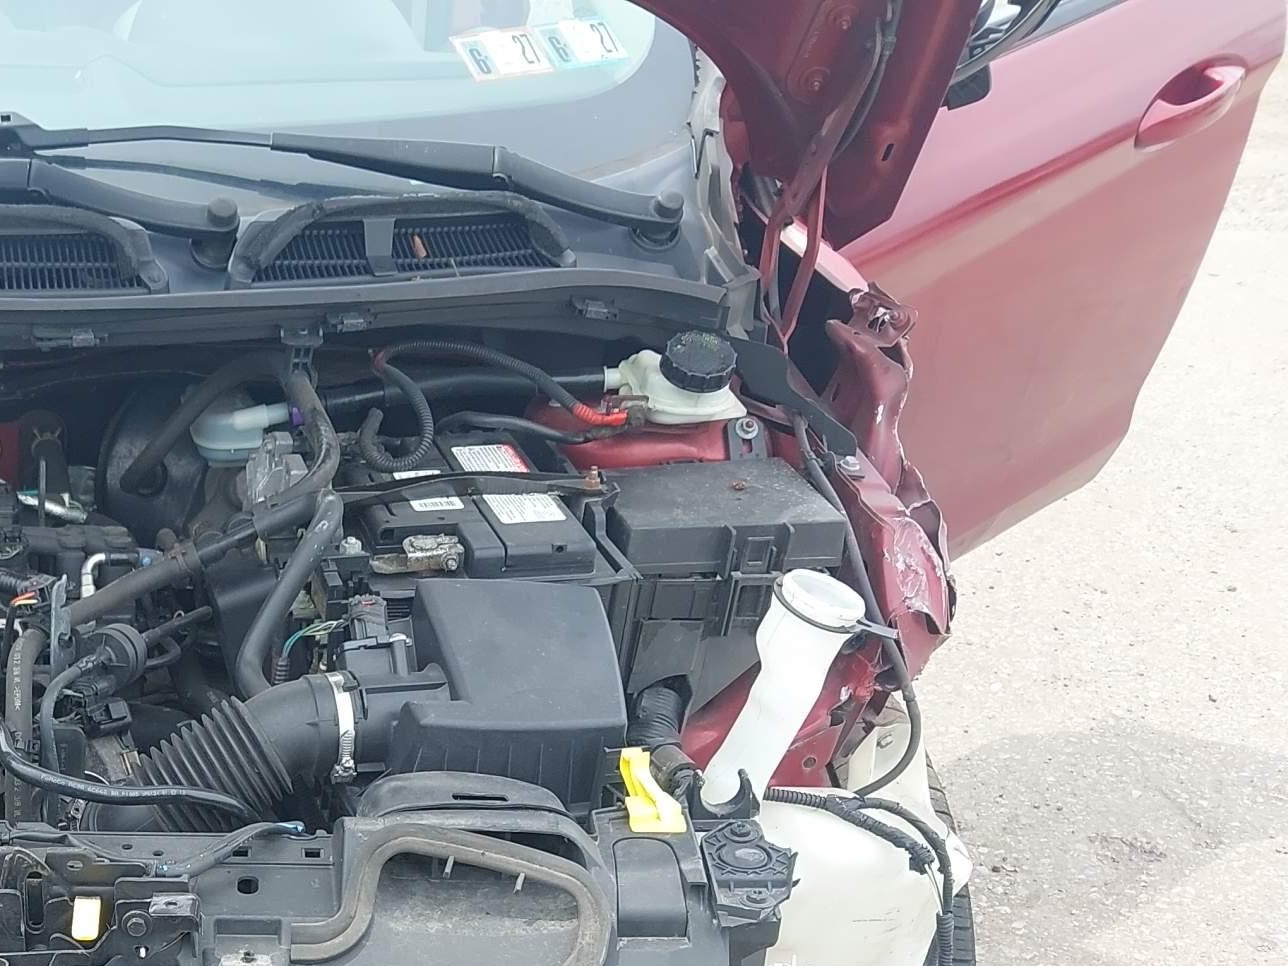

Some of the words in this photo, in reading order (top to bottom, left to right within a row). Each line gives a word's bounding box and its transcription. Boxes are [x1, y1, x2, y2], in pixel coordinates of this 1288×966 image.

[468, 47, 492, 75] 6
[512, 33, 541, 64] 27
[548, 36, 572, 64] 6
[589, 22, 619, 53] 27
